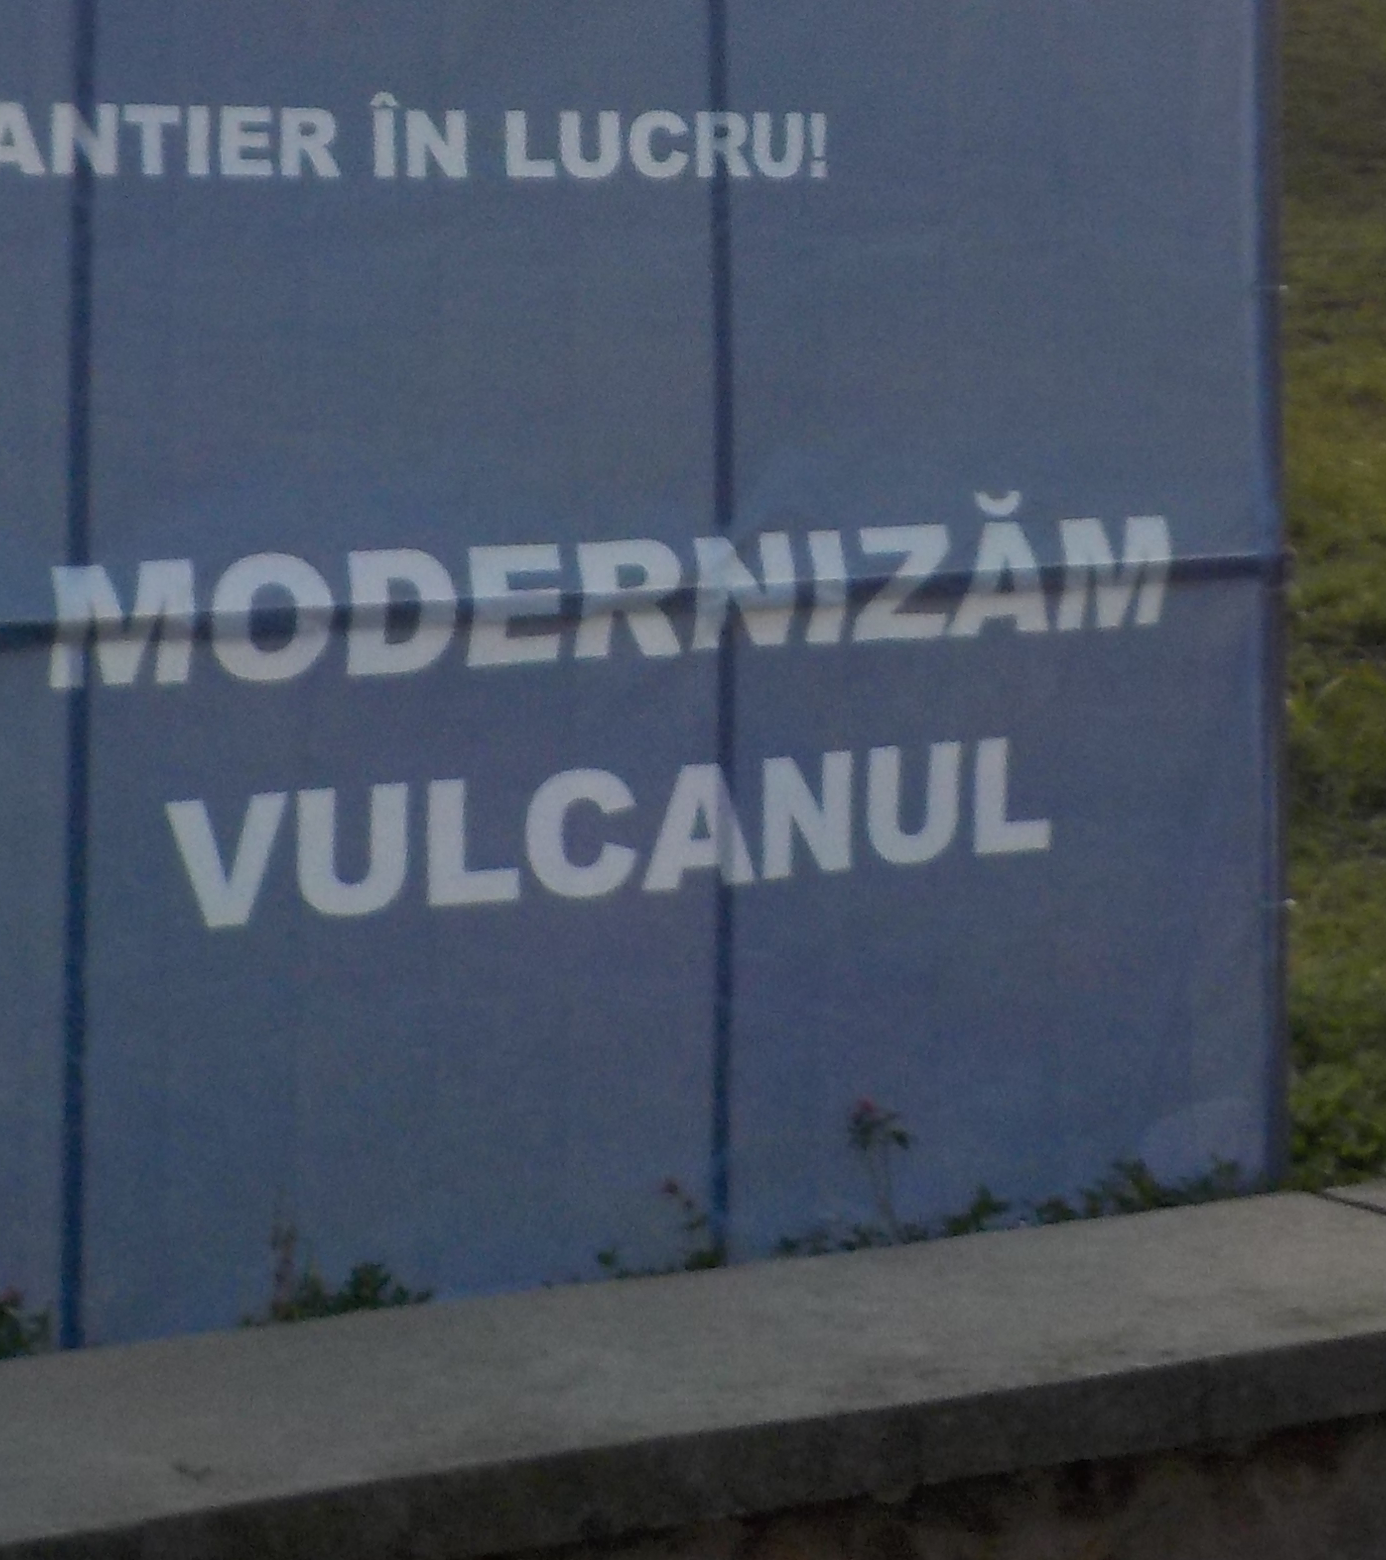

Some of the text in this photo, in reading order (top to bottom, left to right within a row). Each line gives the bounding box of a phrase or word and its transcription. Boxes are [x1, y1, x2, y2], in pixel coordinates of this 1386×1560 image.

[368, 90, 468, 179] ÎN
[502, 107, 830, 181] LUCRU!
[47, 489, 1175, 690] MODERNIZĂM
[165, 736, 1052, 930] VULCANUL
